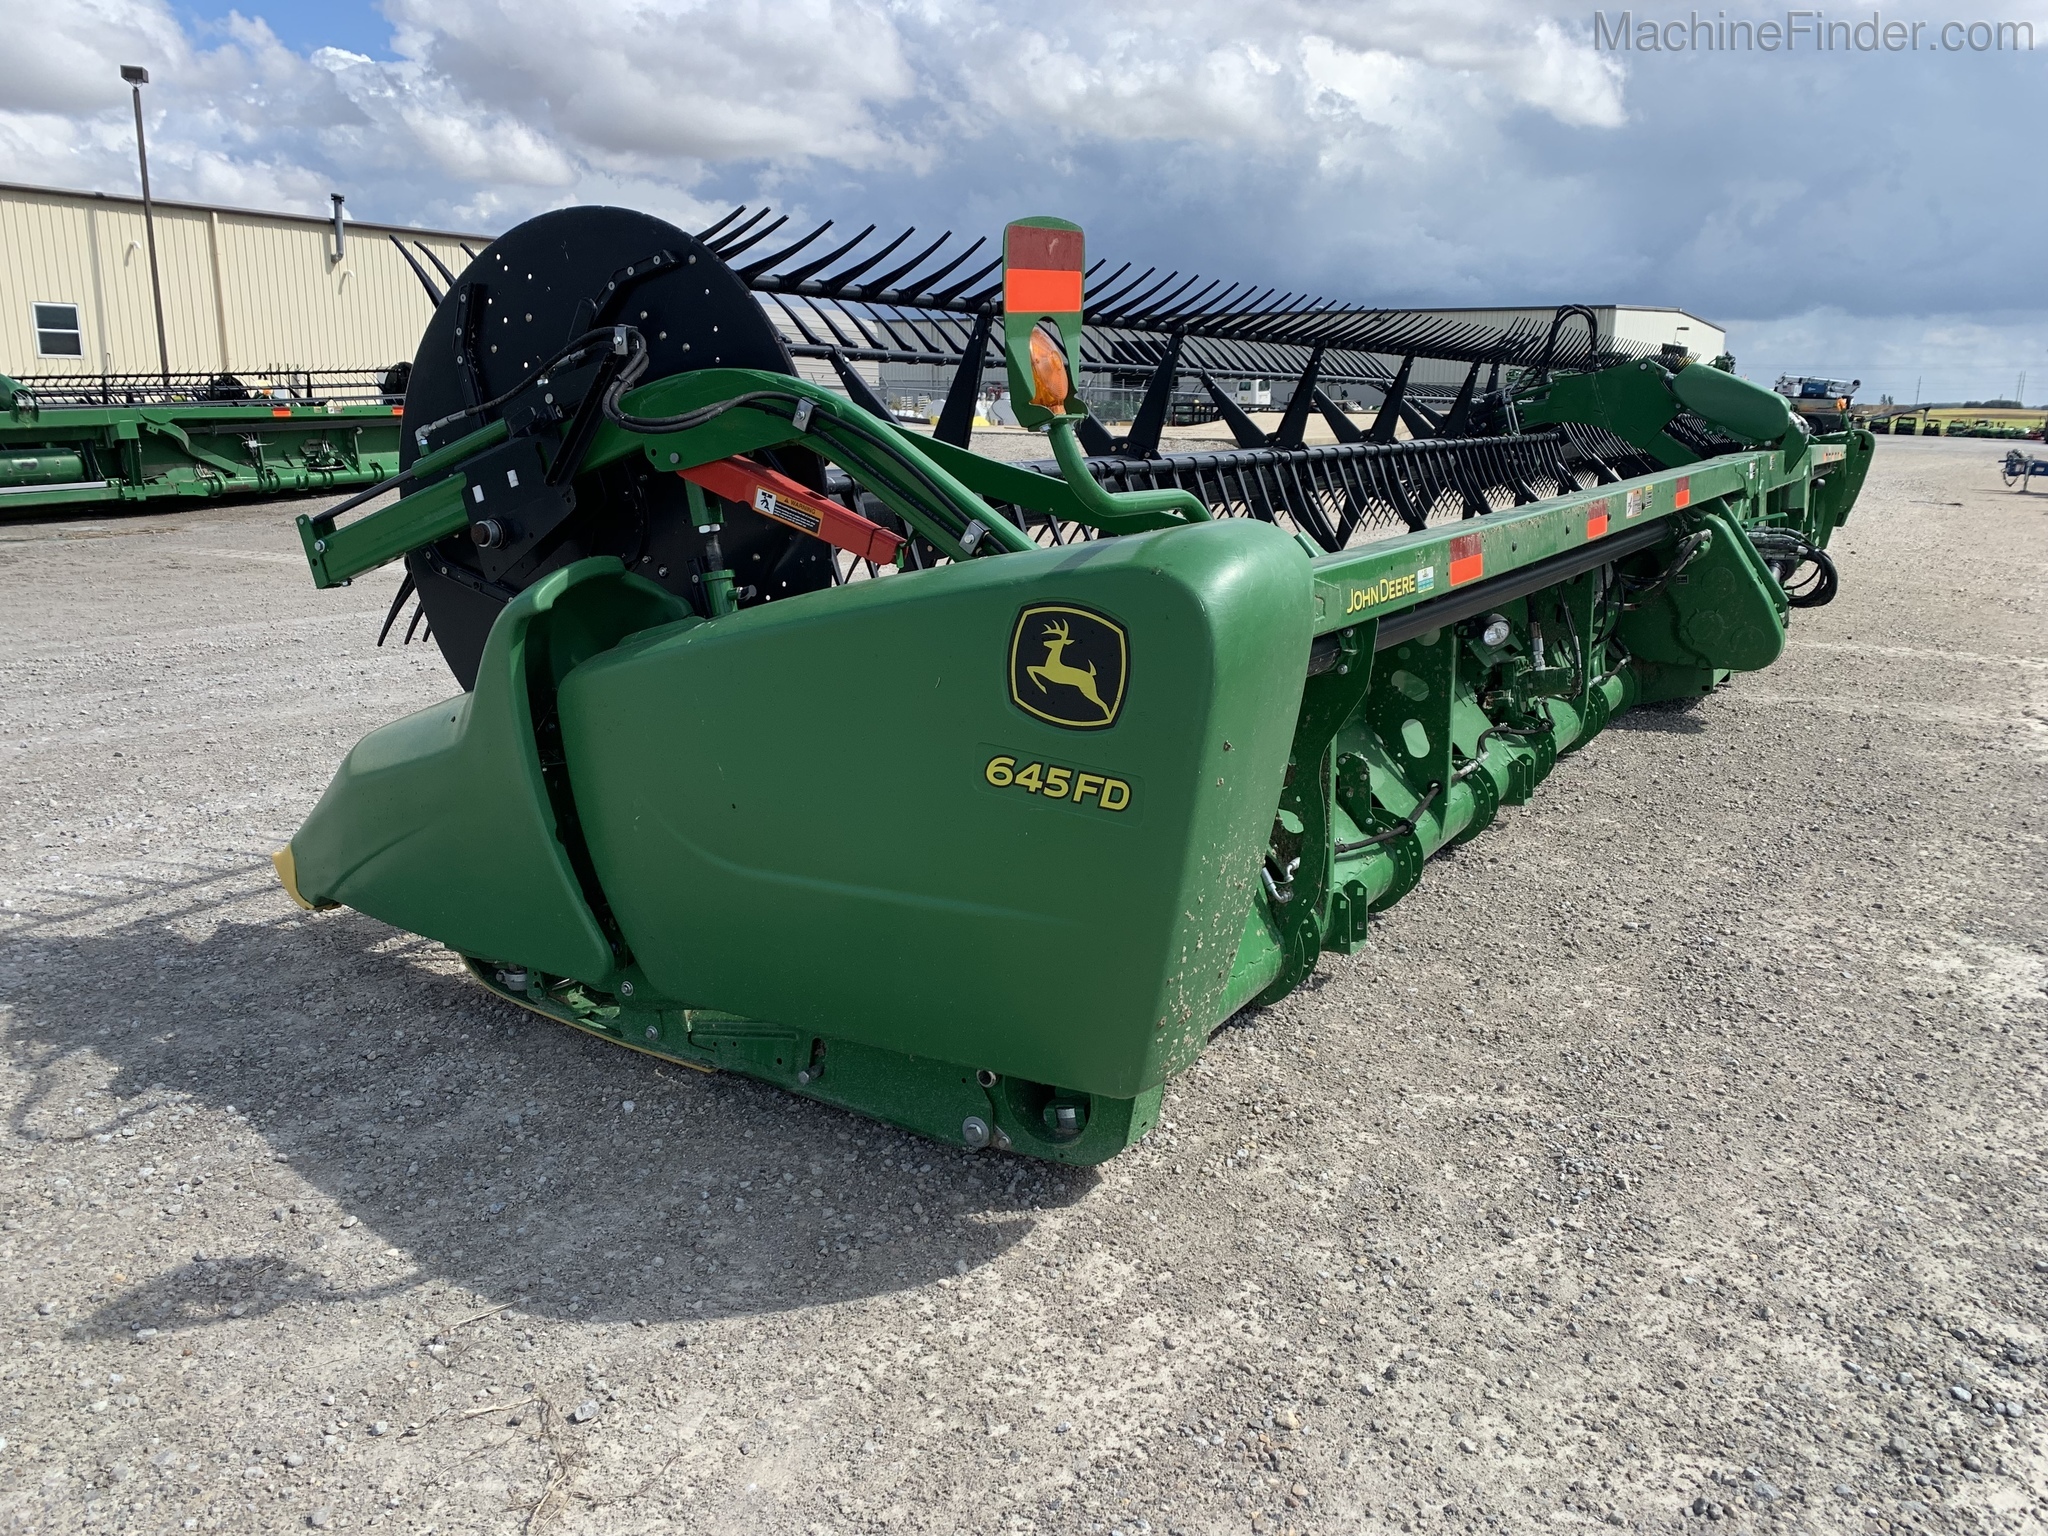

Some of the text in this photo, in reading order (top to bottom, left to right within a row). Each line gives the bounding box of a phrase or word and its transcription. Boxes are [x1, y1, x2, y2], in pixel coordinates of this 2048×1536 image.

[790, 499, 816, 515] WARNING
[1346, 585, 1379, 614] JOHN
[1379, 573, 1416, 603] DEERE
[985, 755, 1132, 812] 645FD
